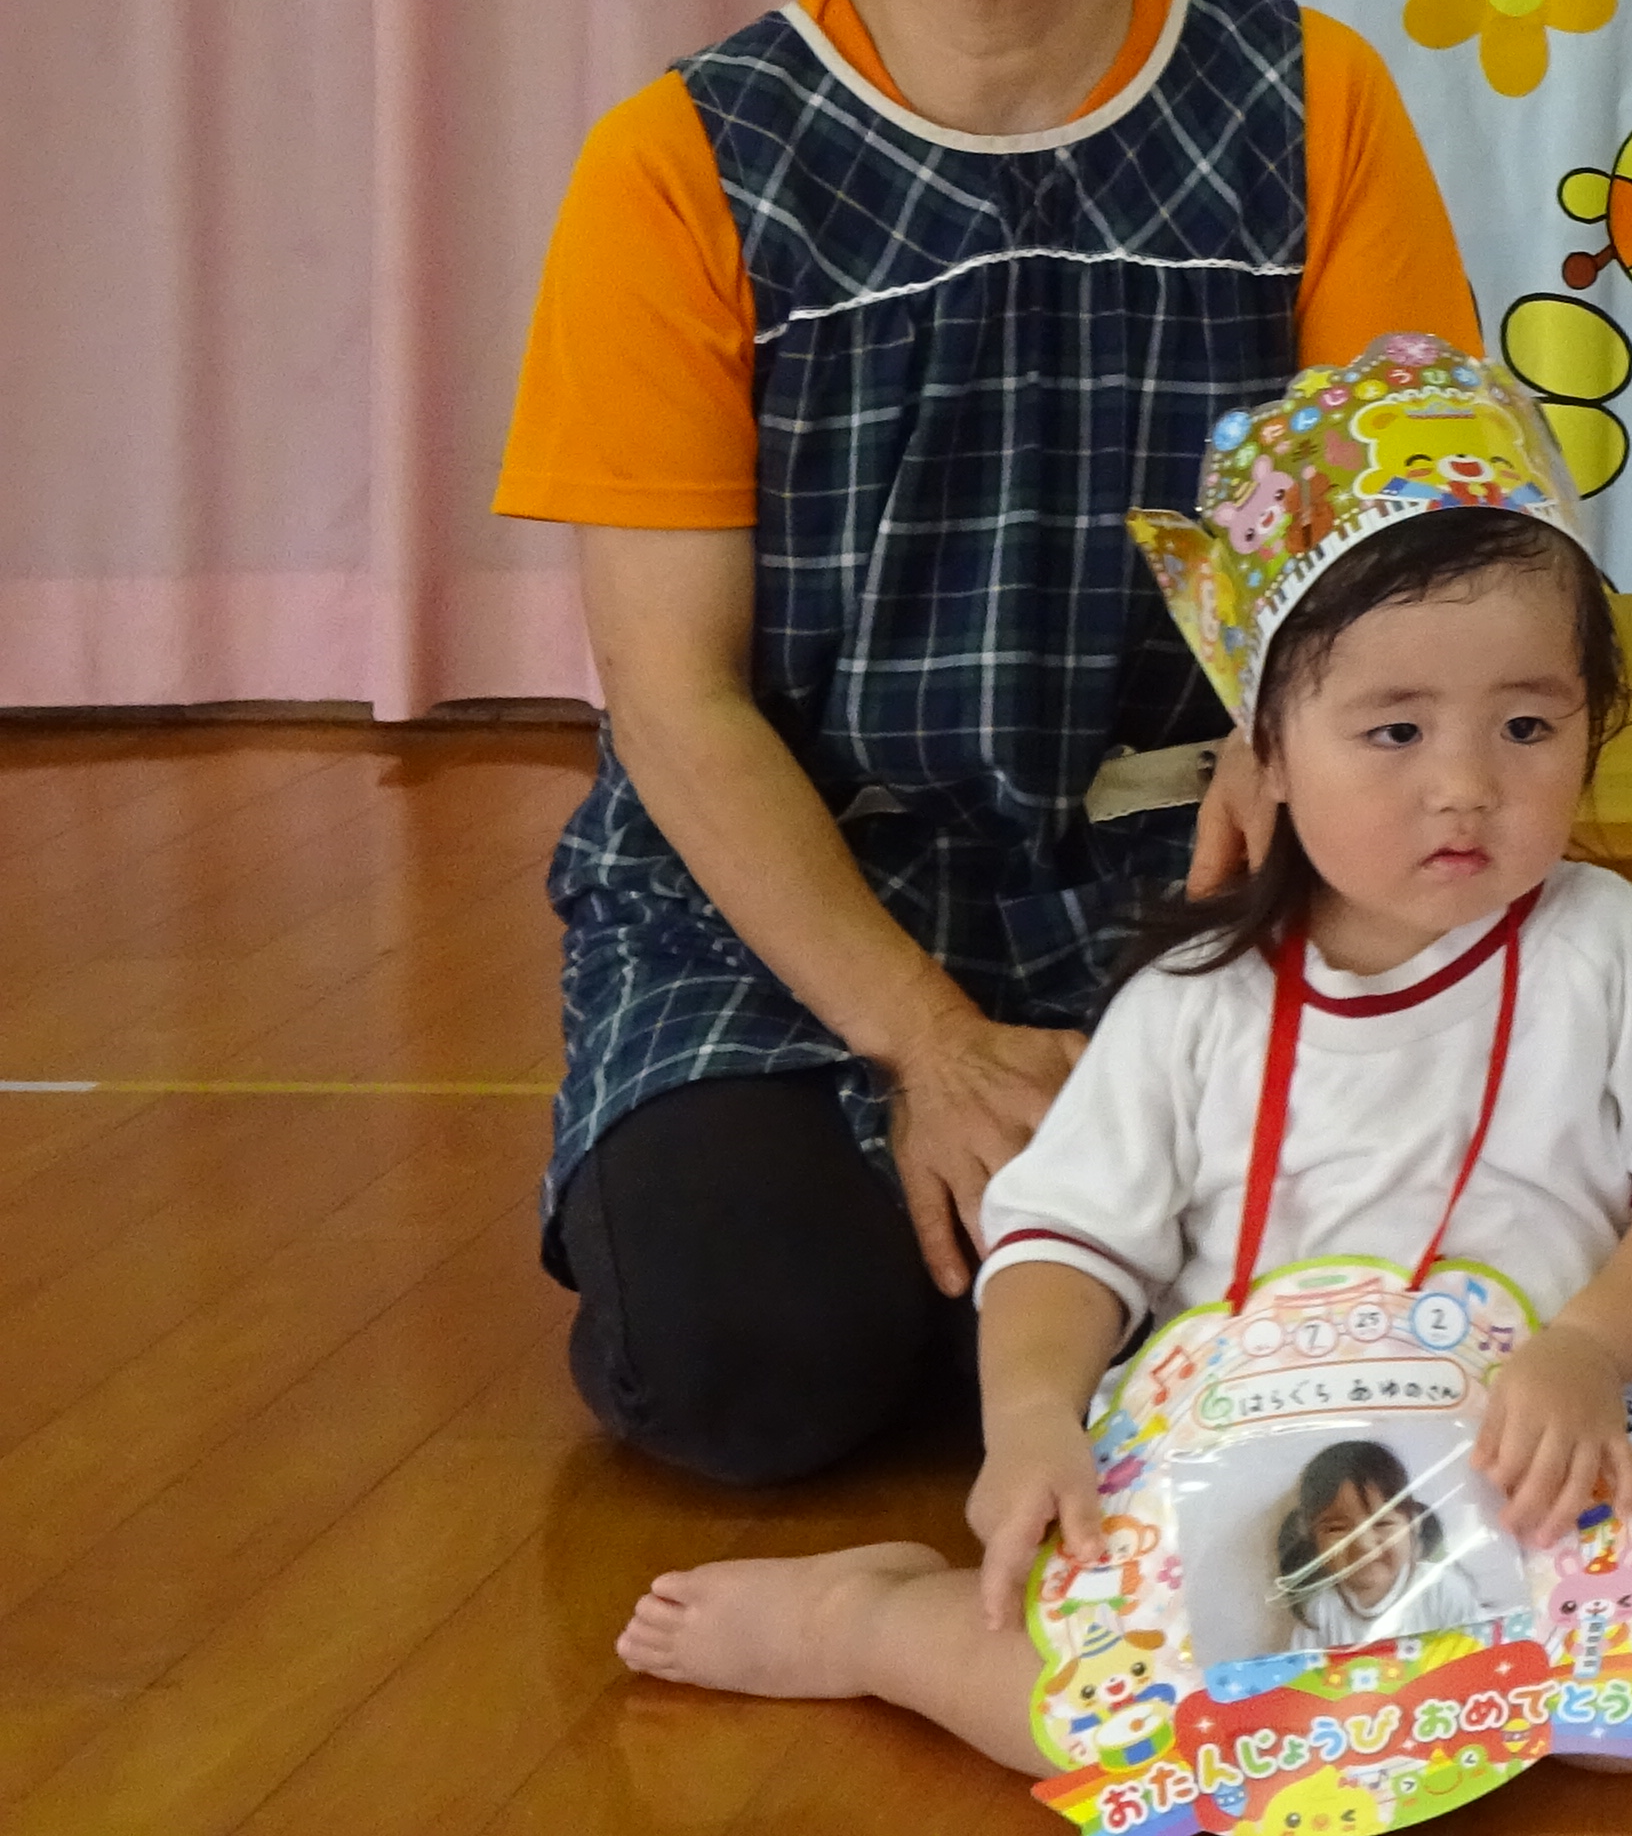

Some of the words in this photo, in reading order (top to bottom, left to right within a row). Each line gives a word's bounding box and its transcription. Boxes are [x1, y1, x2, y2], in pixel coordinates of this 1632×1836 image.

[1430, 1308, 1448, 1331] 2
[1099, 1704, 1402, 1833] おたんじょうび
